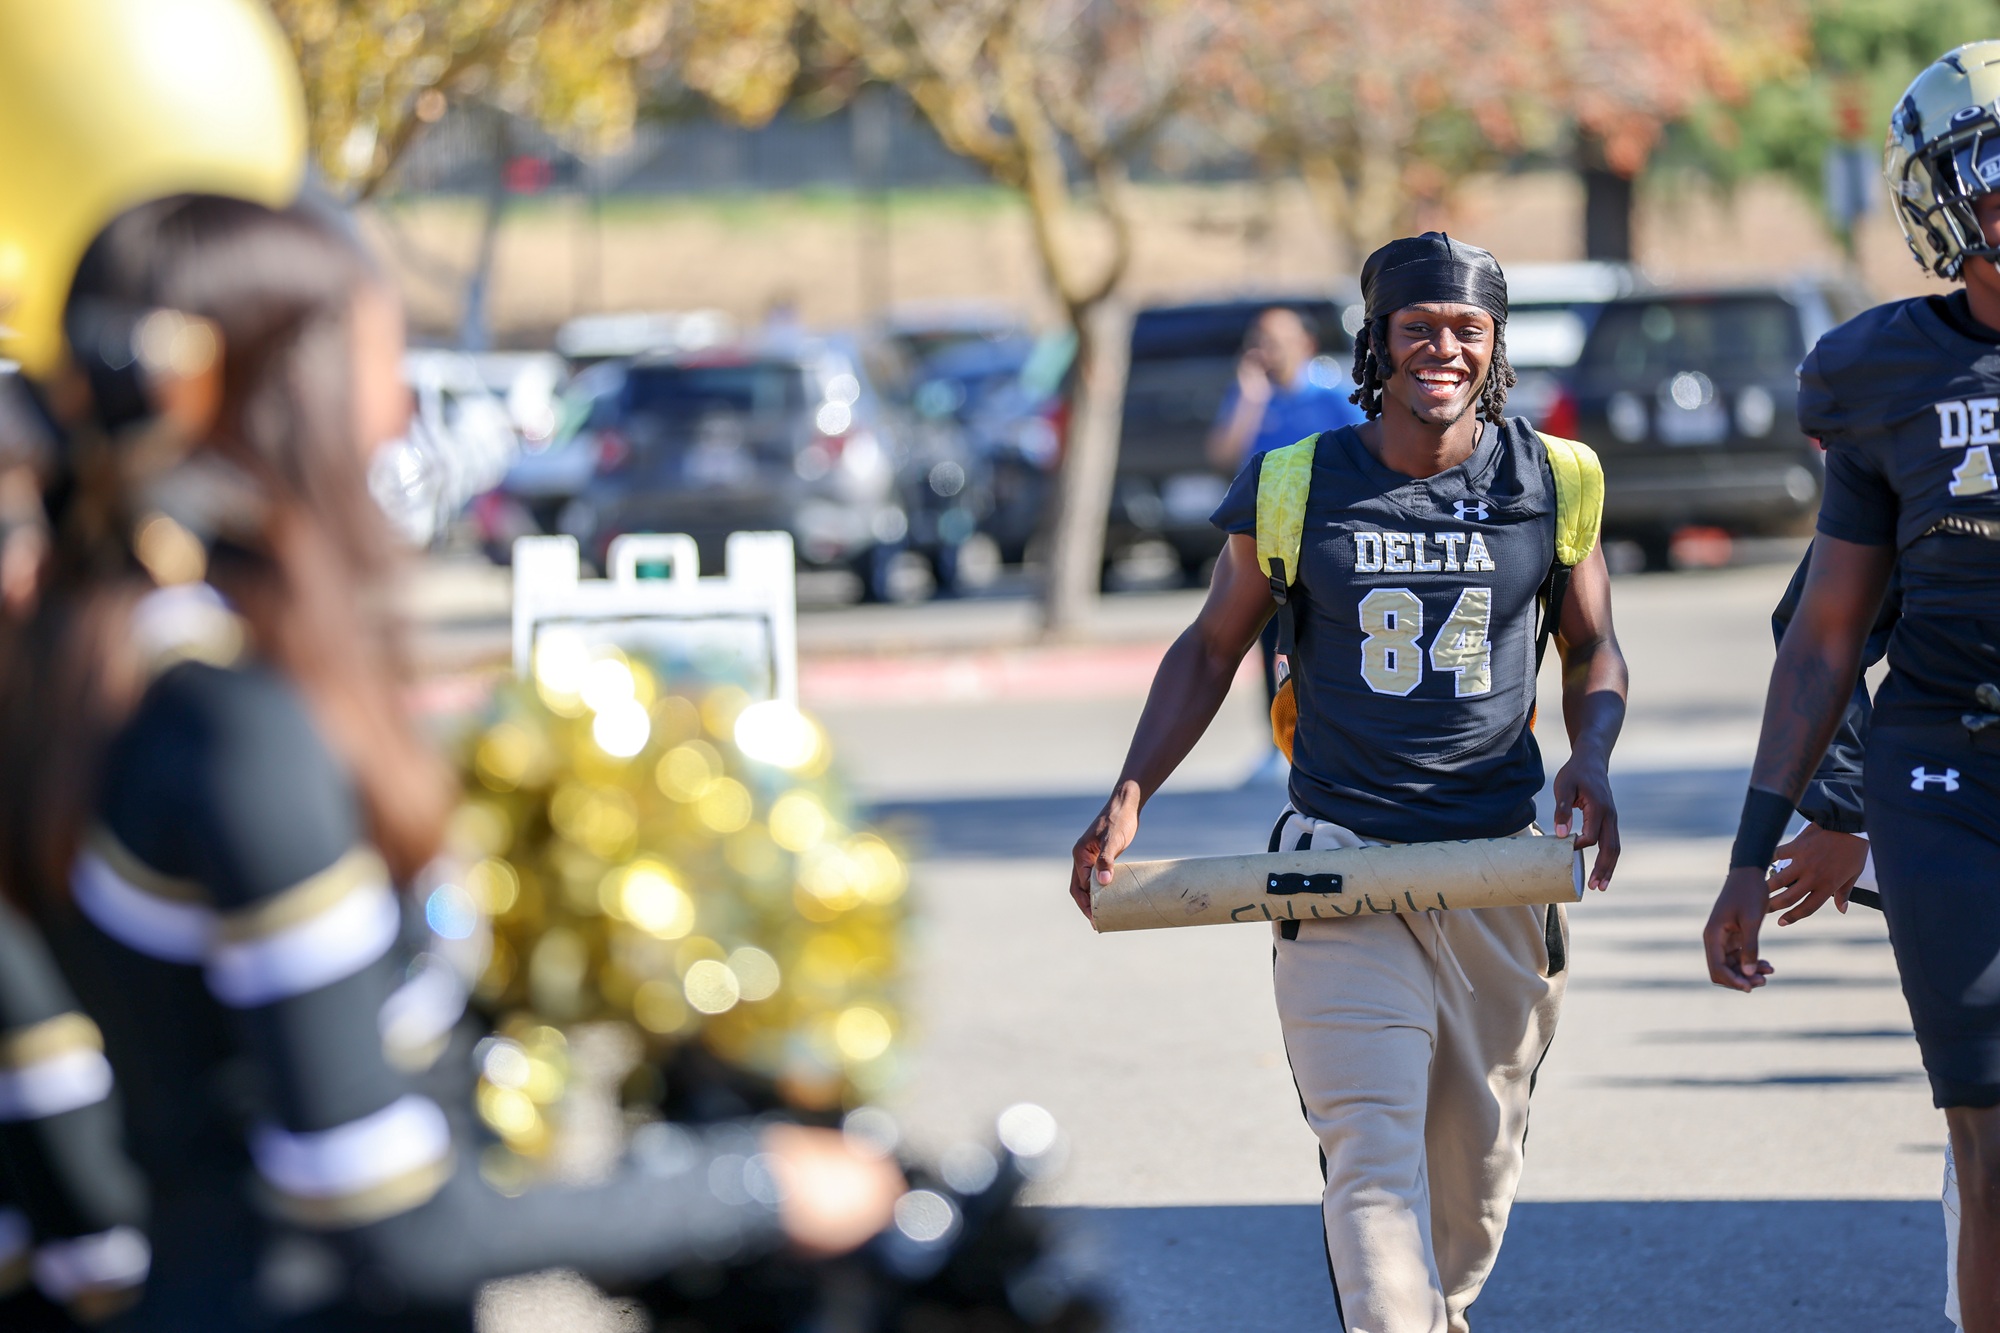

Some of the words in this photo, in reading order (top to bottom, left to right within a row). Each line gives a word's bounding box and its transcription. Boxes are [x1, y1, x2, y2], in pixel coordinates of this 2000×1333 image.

[1949, 445, 1998, 497] 1
[1353, 531, 1496, 573] DELTA
[1358, 587, 1492, 698] 84
